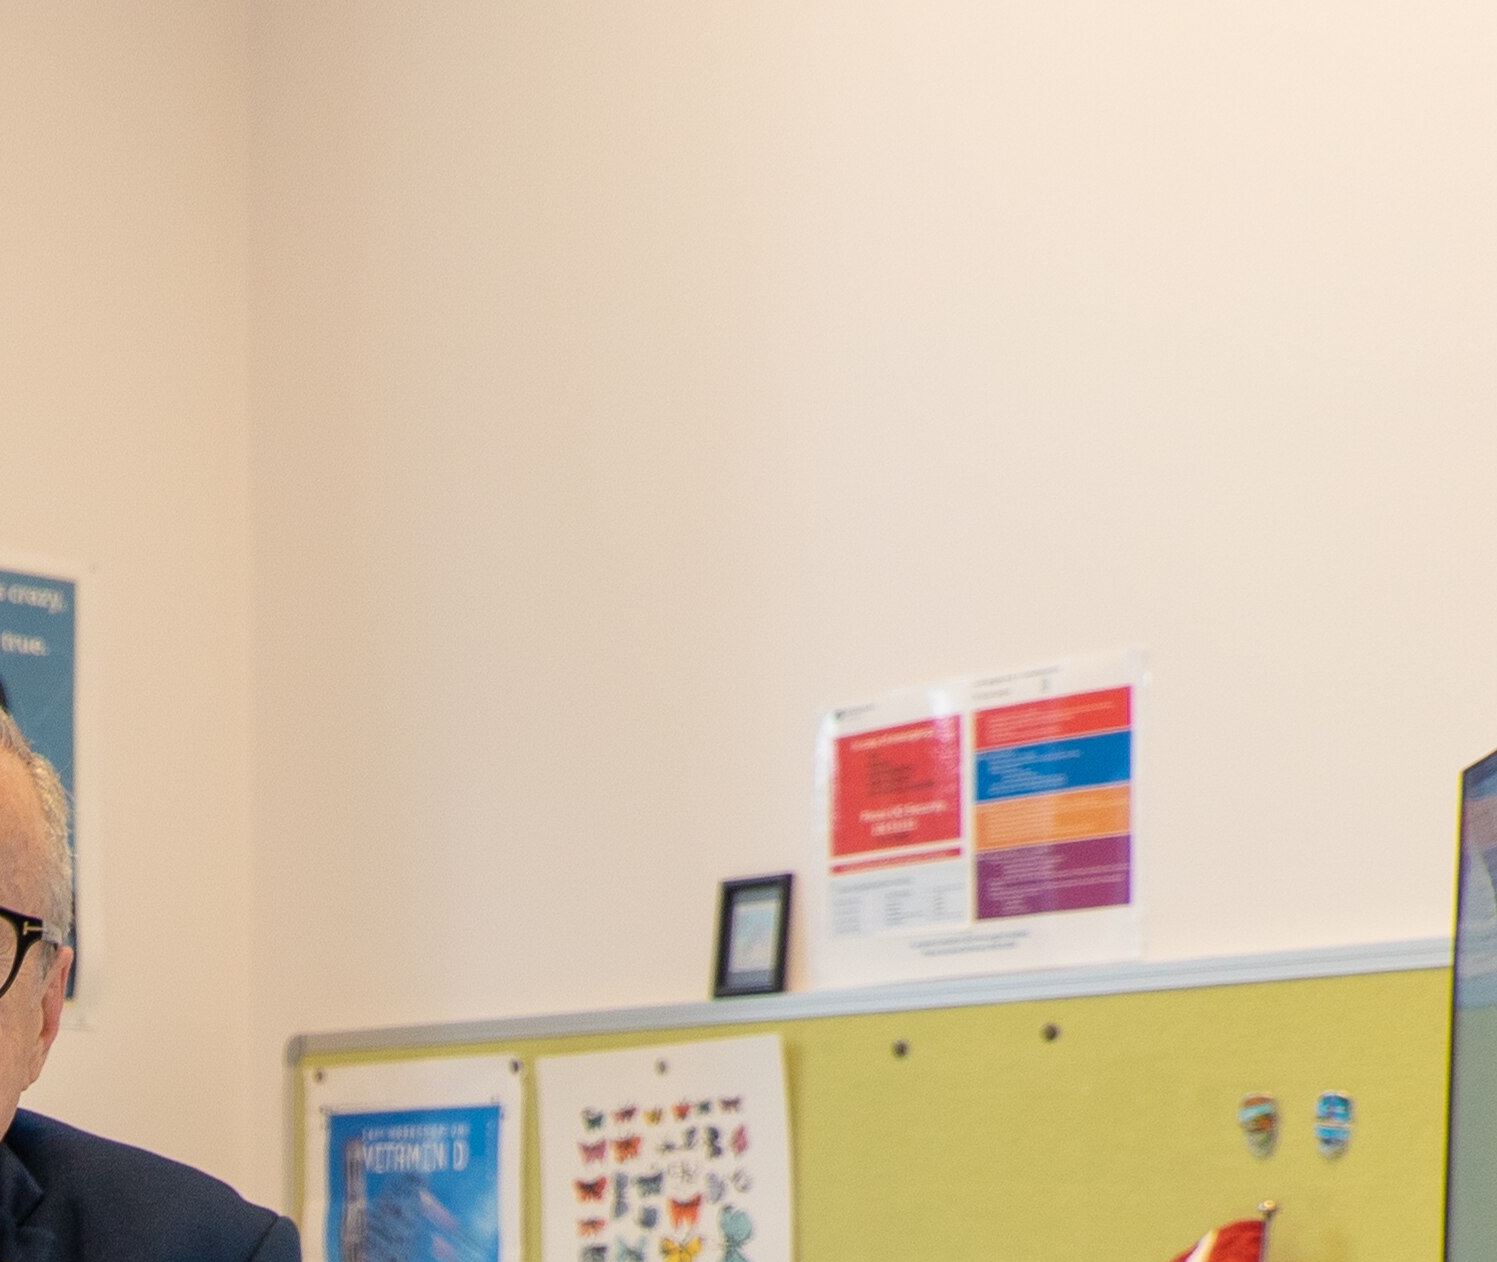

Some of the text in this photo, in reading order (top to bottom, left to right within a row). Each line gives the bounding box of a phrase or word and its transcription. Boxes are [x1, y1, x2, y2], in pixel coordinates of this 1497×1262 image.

[1, 631, 47, 656] true.
[363, 1140, 469, 1173] VITAMIN D
